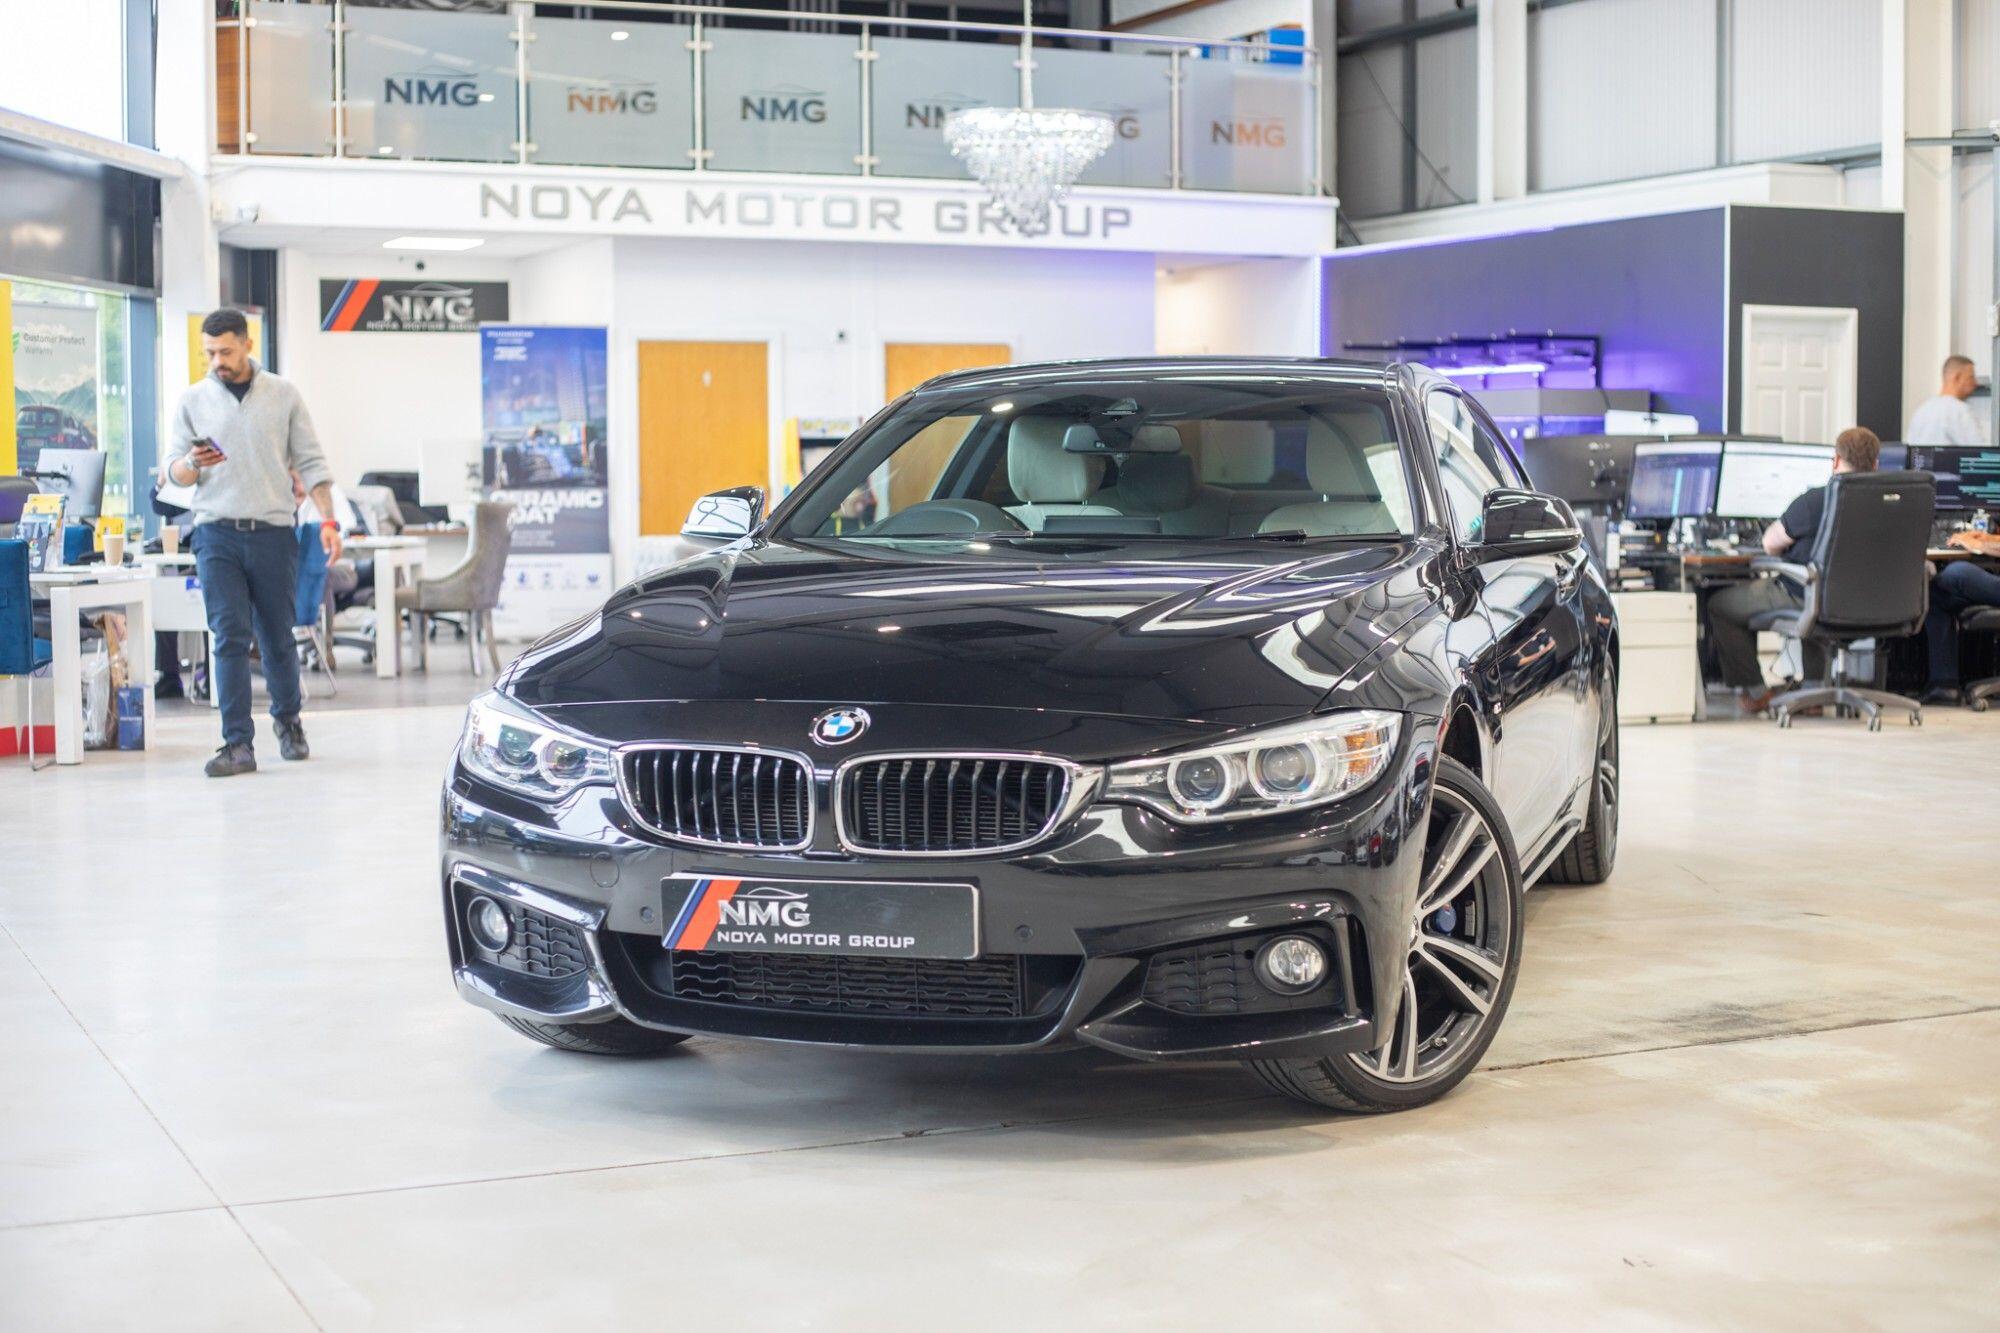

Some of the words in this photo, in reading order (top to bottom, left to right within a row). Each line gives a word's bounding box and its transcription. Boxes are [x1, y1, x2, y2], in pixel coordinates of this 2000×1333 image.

[384, 79, 478, 106] NMG
[567, 88, 657, 114] NMG
[740, 97, 826, 123] NMG
[1211, 120, 1286, 148] NMG
[481, 183, 653, 223] NOYA
[686, 190, 902, 231] MOTOR
[382, 294, 475, 321] NMG
[23, 332, 57, 343] Customer
[60, 334, 86, 345] Protect
[718, 900, 810, 927] NMG
[717, 931, 767, 944] NOYA
[774, 934, 841, 946] MOTOR
[849, 935, 915, 948] GROUP
